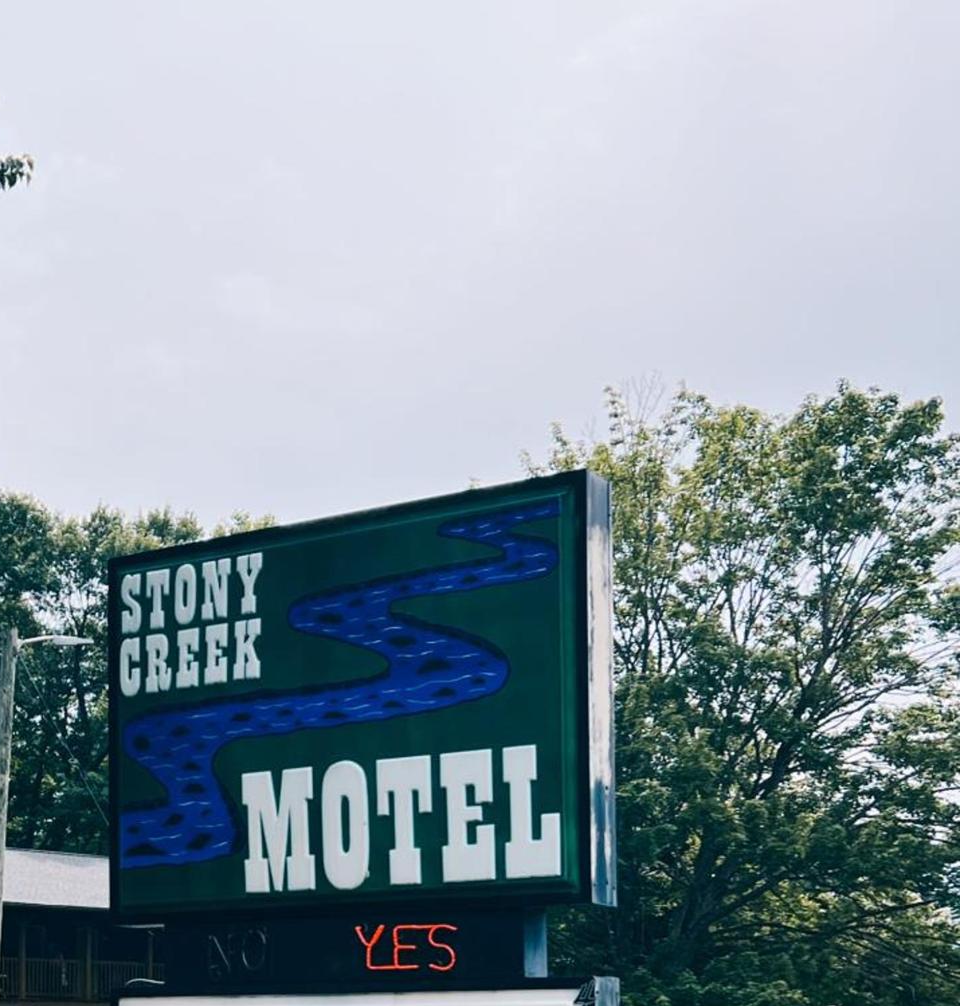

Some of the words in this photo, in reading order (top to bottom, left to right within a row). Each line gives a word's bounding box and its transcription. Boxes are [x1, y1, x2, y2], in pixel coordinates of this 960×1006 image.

[121, 552, 263, 634] STONY
[119, 618, 262, 697] CREEK
[241, 744, 562, 894] MOTEL
[208, 928, 268, 974] NO
[354, 923, 458, 971] YES
